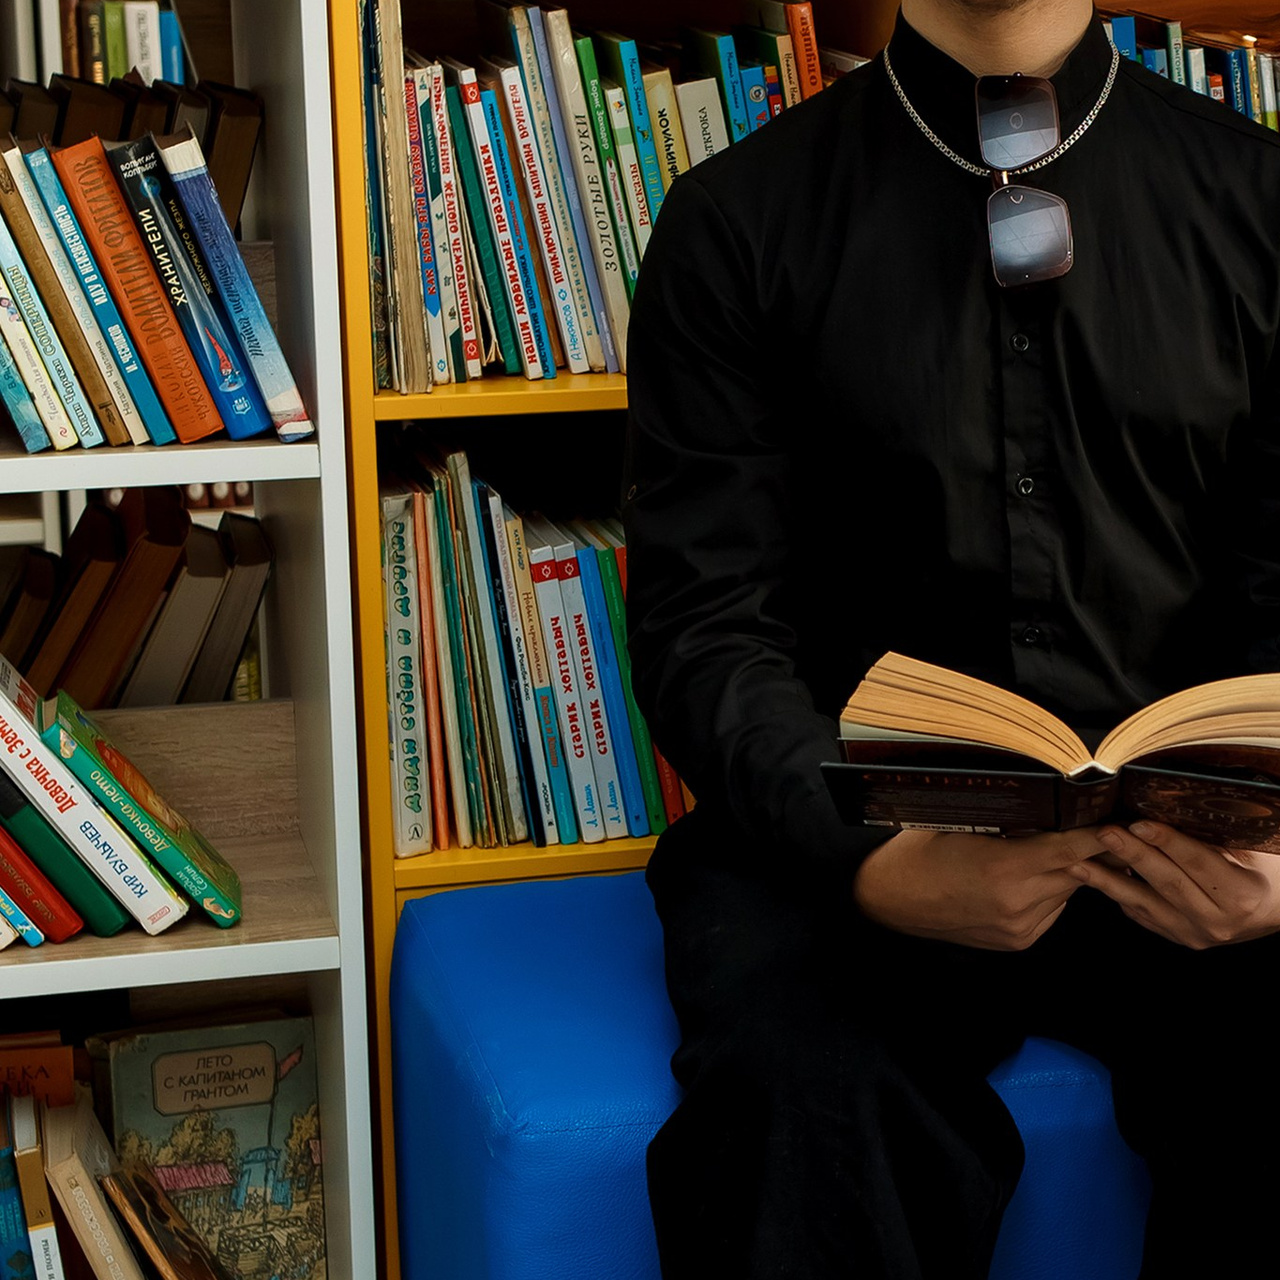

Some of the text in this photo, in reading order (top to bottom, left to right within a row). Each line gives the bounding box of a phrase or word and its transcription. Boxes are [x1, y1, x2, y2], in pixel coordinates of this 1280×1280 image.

[138, 208, 187, 306] ХРАНИТЕЛИ
[480, 144, 538, 363] НАШИ ЛЮБИМЫЕ ПРАЗДНИКИ
[90, 770, 170, 852] Девочка-лето
[79, 820, 148, 899] КИР БУЛЫЧЕВ
[164, 1066, 266, 1089] С КАПИТАНОМ
[183, 1083, 249, 1102] ГРАНТОМ
[196, 1055, 233, 1070] ЛЕТО
